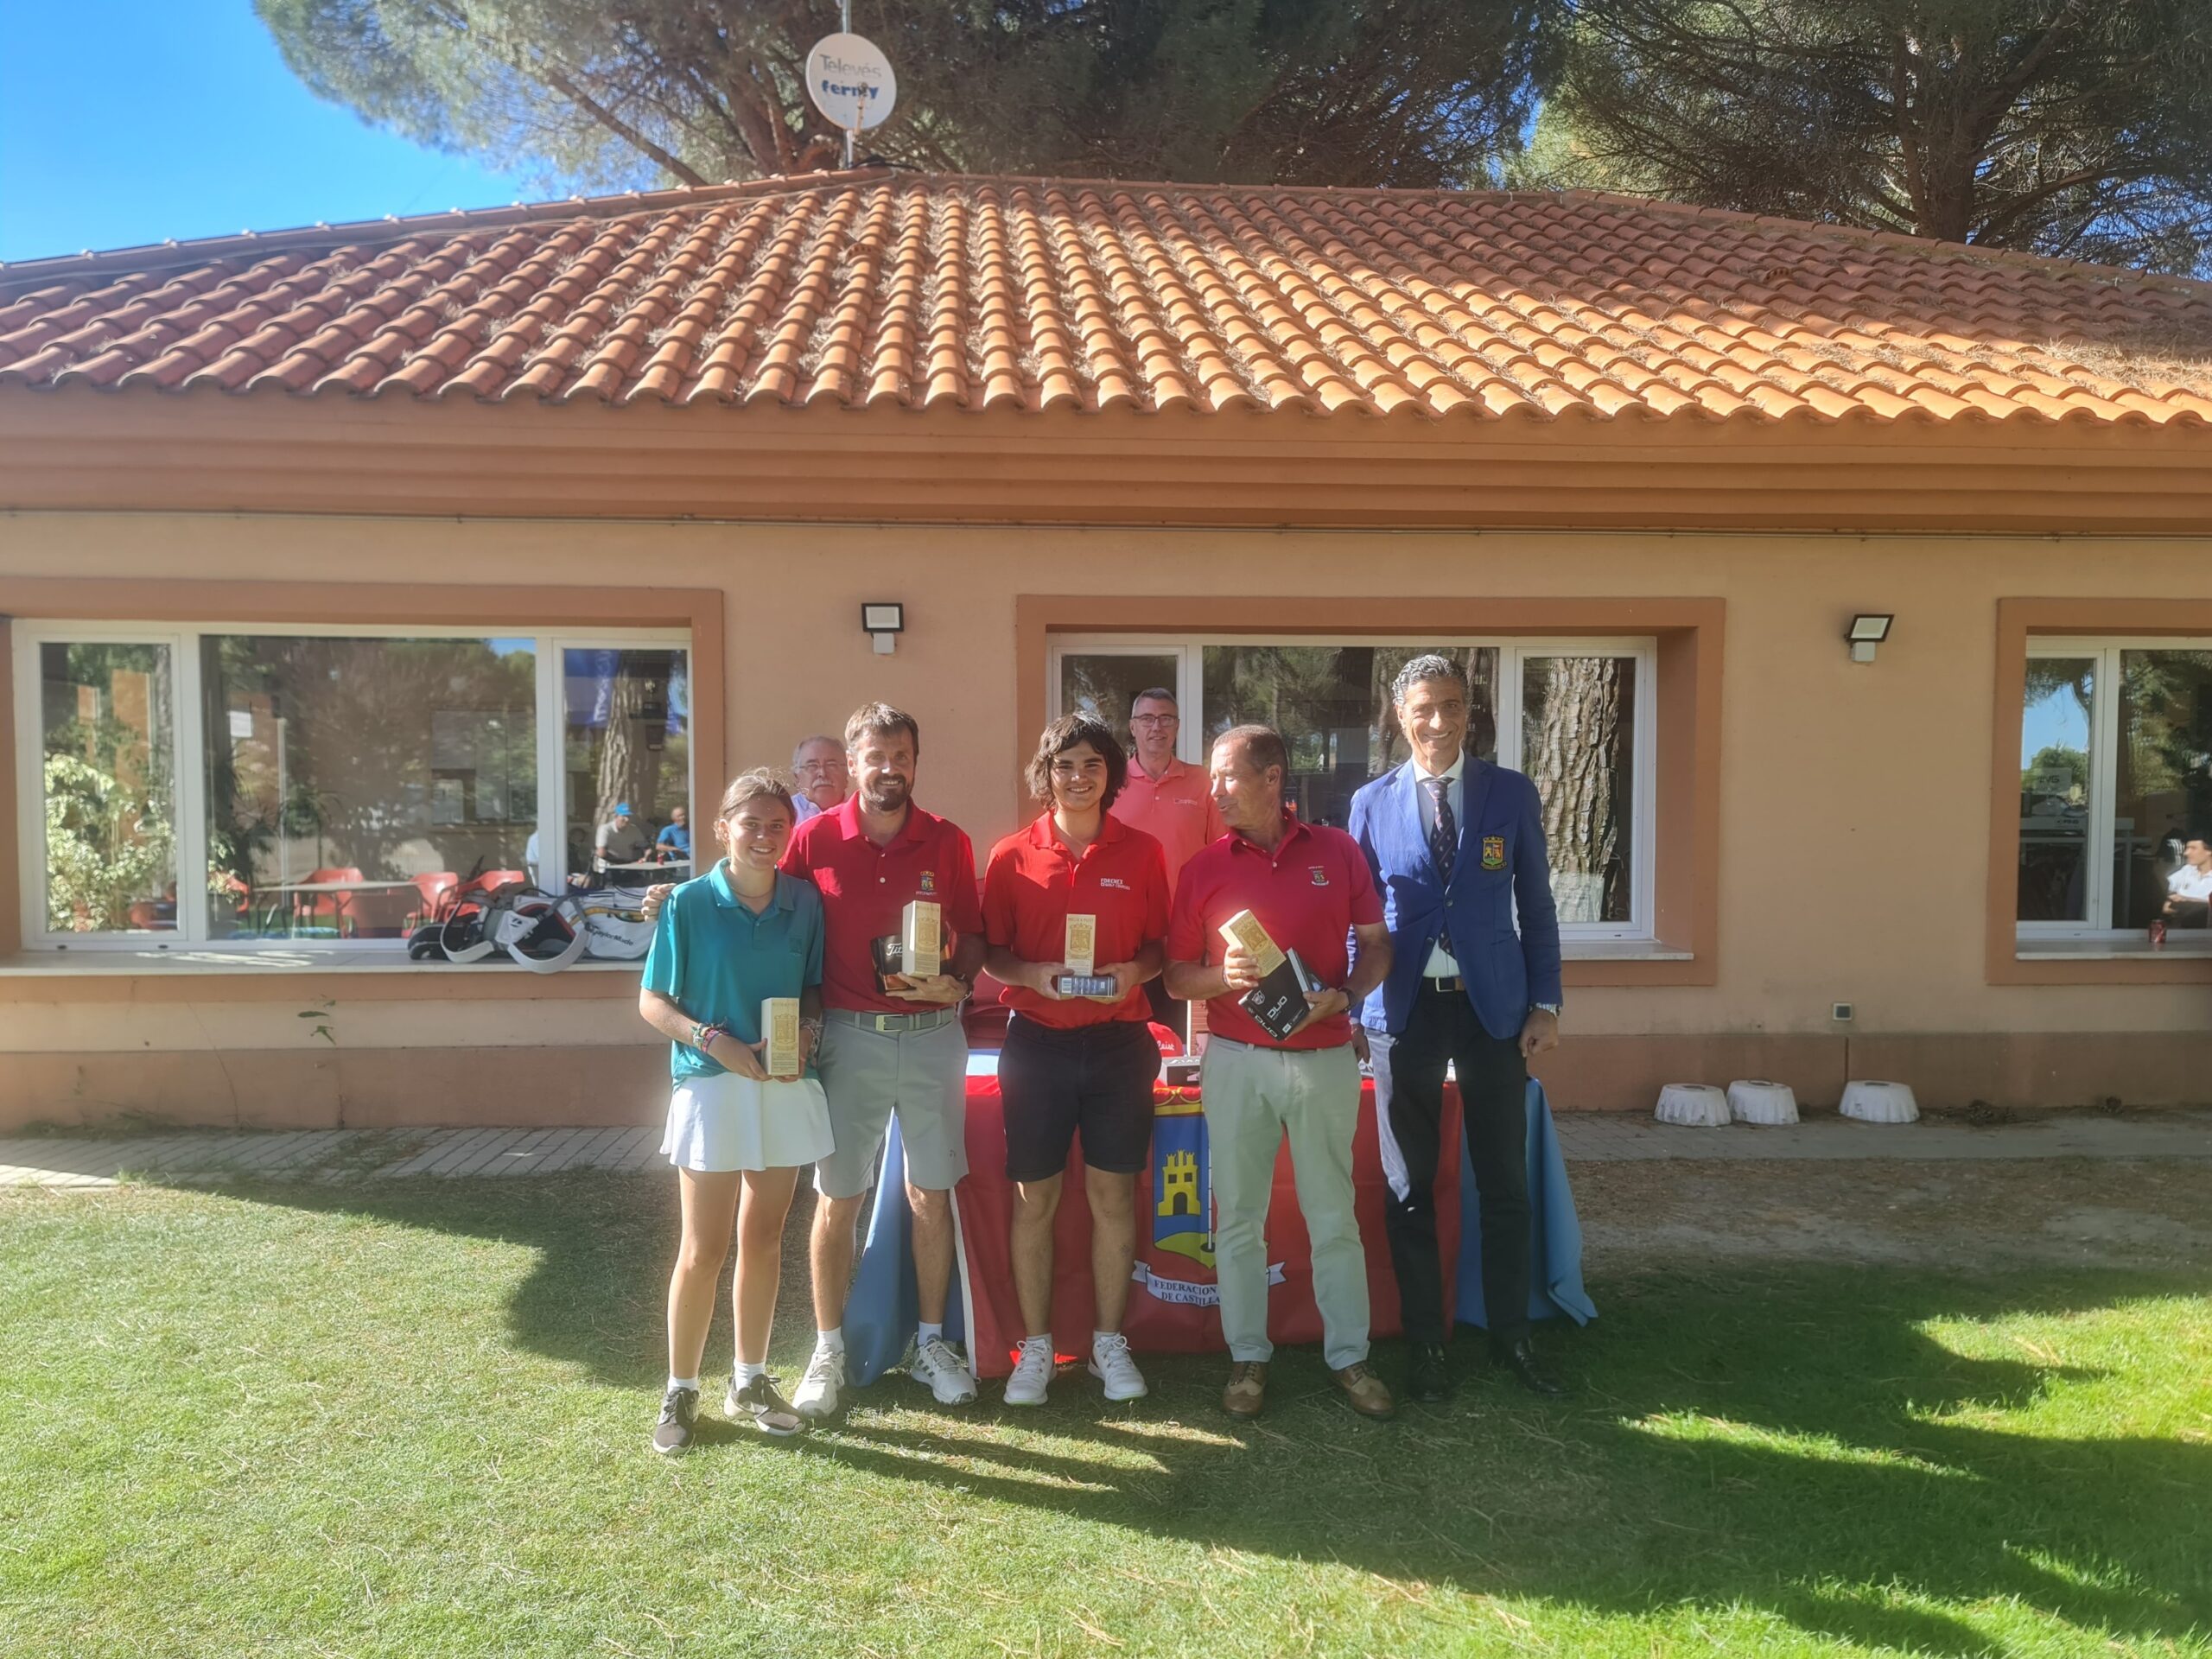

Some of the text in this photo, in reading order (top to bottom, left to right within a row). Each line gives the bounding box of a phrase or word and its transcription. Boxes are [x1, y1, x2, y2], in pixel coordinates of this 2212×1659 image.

[819, 54, 881, 78] Televés
[1267, 995, 1287, 1019] DUO
[1255, 1014, 1278, 1038] DUO
[1154, 1280, 1217, 1295] FEDERACION
[1161, 1292, 1173, 1301] DE
